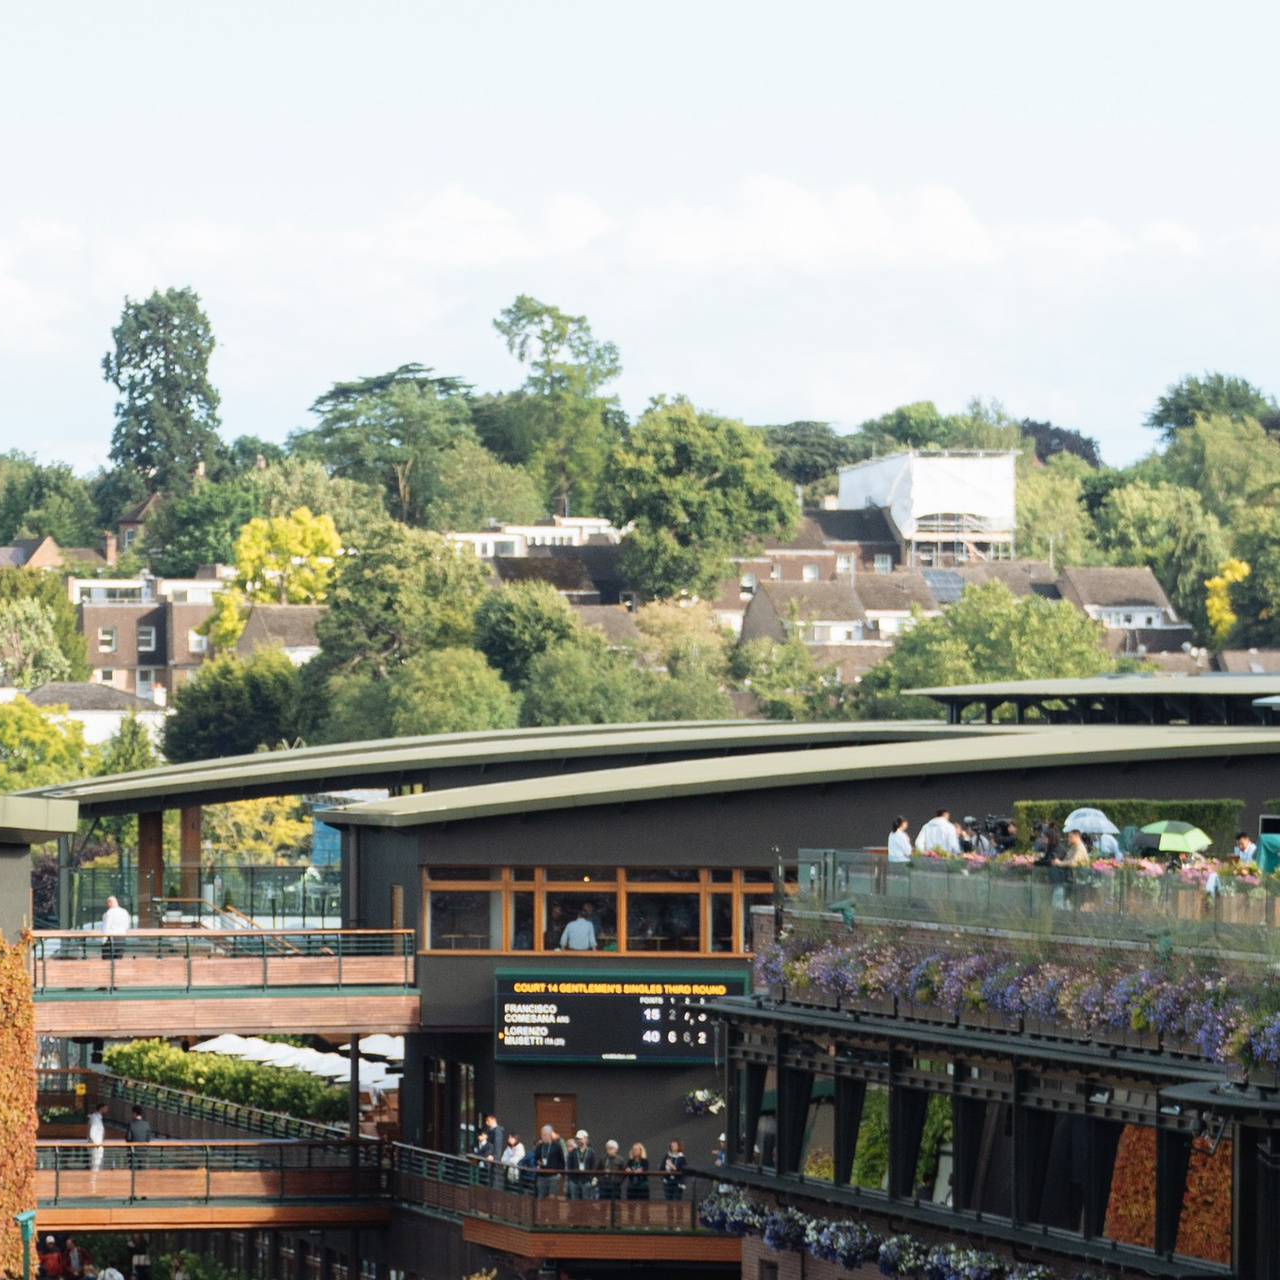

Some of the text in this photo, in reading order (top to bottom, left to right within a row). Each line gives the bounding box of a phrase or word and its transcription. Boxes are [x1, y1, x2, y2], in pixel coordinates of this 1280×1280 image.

[514, 983, 727, 995] COURT 14 GENTLEMEN'S SINGLES THIRD ROUND
[639, 996, 664, 1004] POINTS
[504, 1004, 558, 1014] FRANCISCO
[504, 1014, 556, 1024] COMESANA
[643, 1008, 661, 1021] 15
[668, 1009, 677, 1021] 2
[504, 1026, 549, 1036] LORENZO
[504, 1036, 544, 1046] MUSETTI
[642, 1030, 707, 1044] 40 6 6 2
